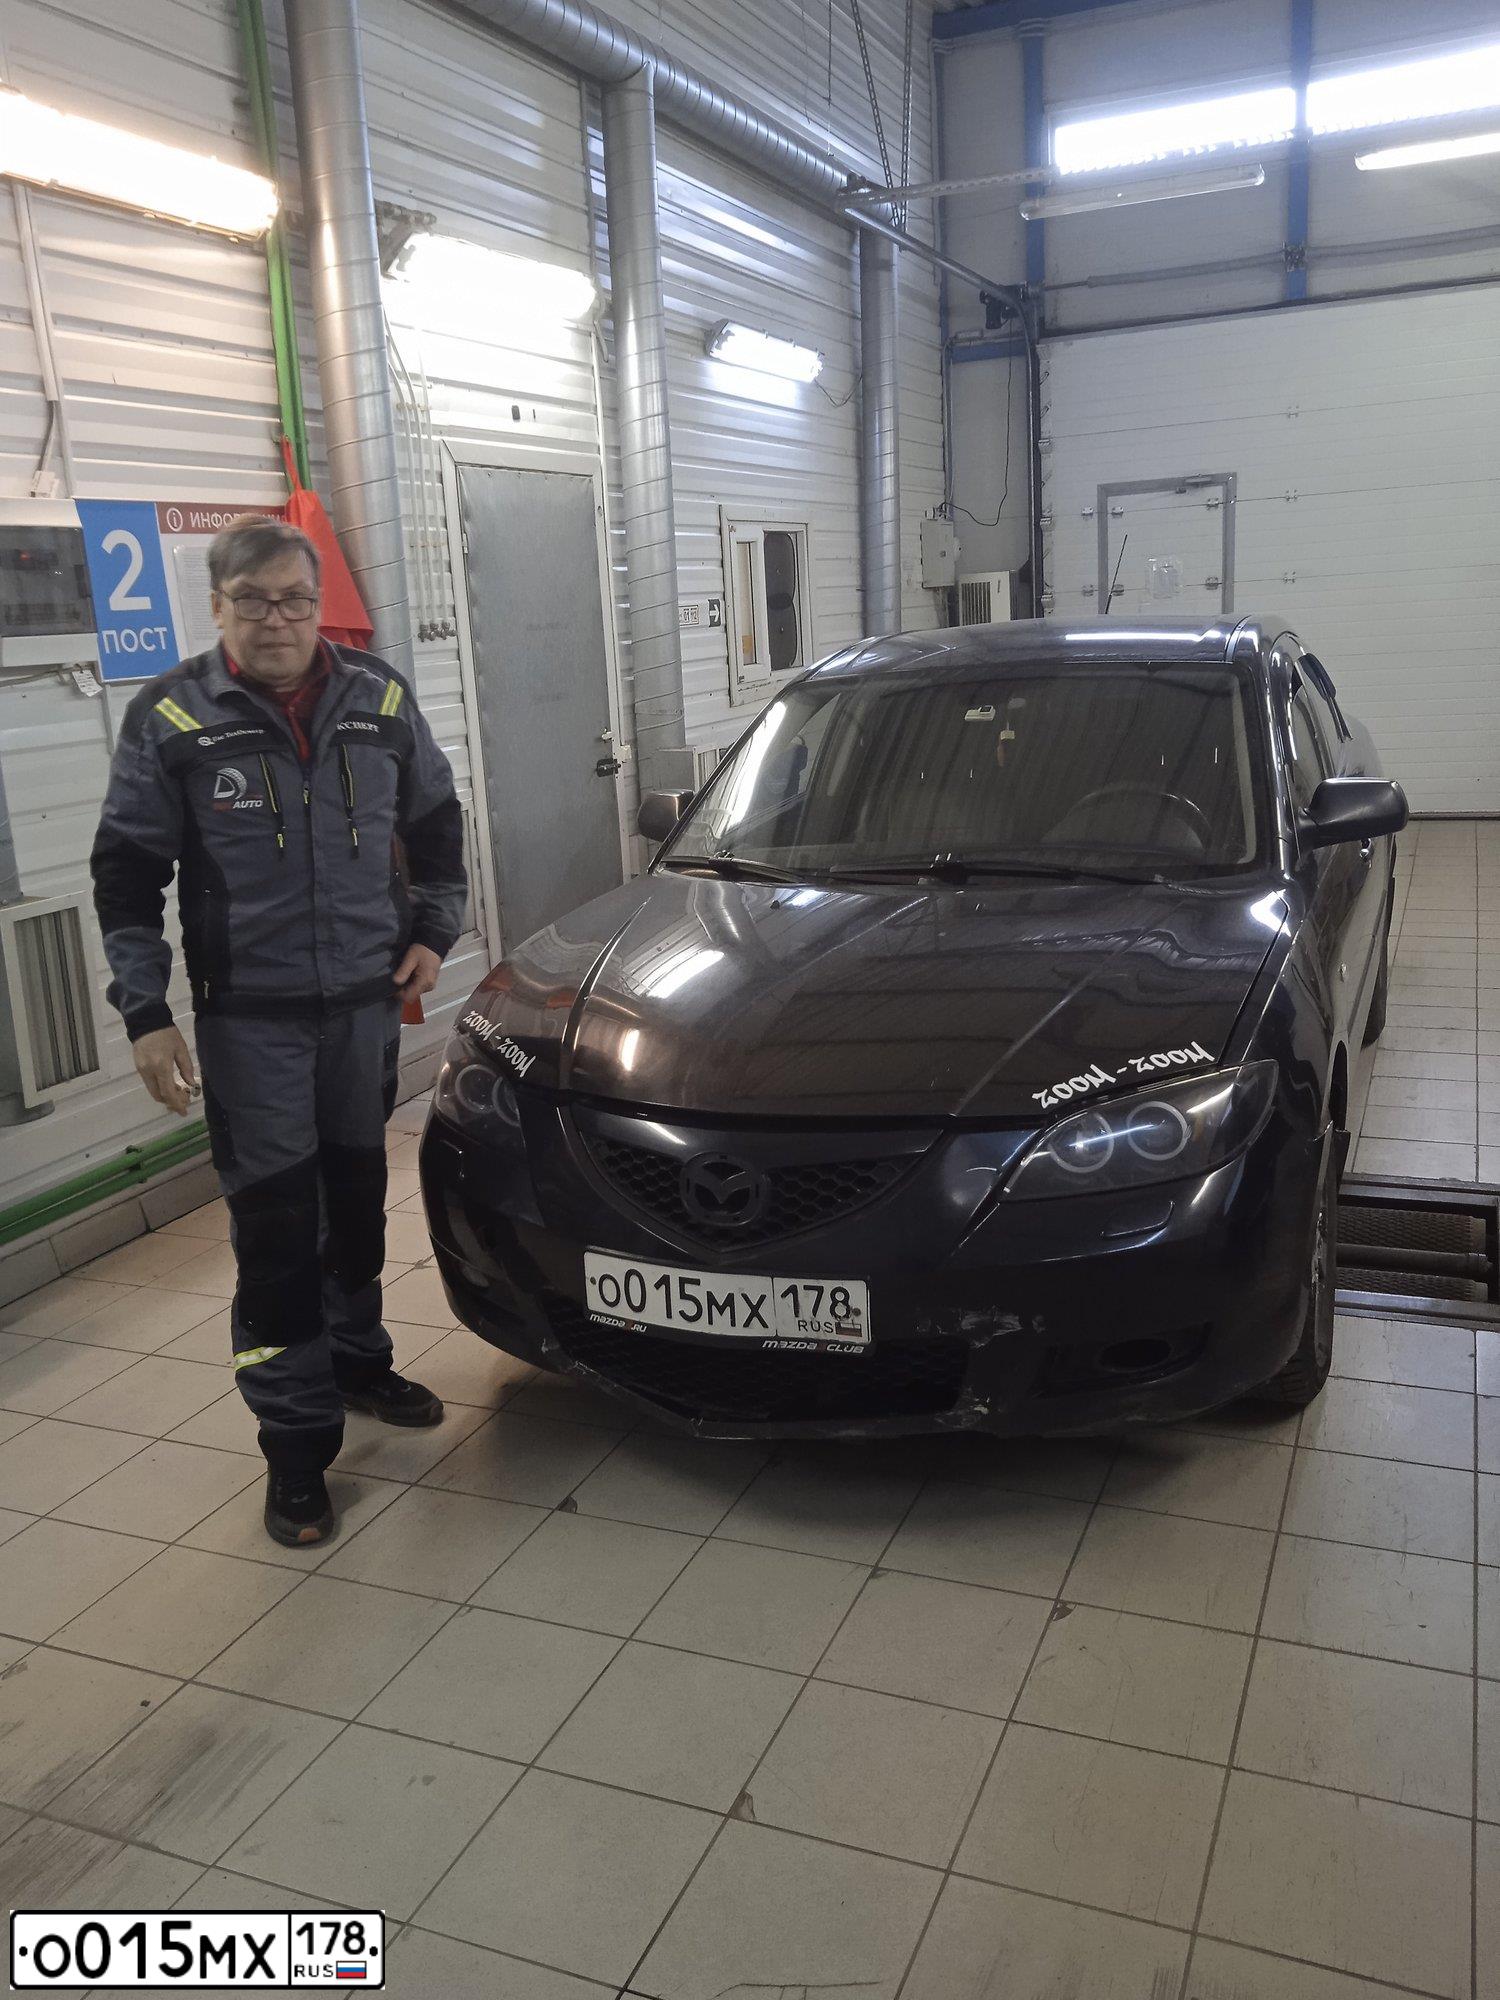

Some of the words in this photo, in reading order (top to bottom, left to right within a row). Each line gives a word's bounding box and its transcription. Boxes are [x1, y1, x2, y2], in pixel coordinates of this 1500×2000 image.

[101, 529, 152, 612] 2
[102, 626, 168, 655] ПОСТ
[233, 800, 263, 809] AUTO
[780, 1284, 852, 1320] 178
[797, 1319, 834, 1334] RUS
[826, 1343, 864, 1353] CLUB
